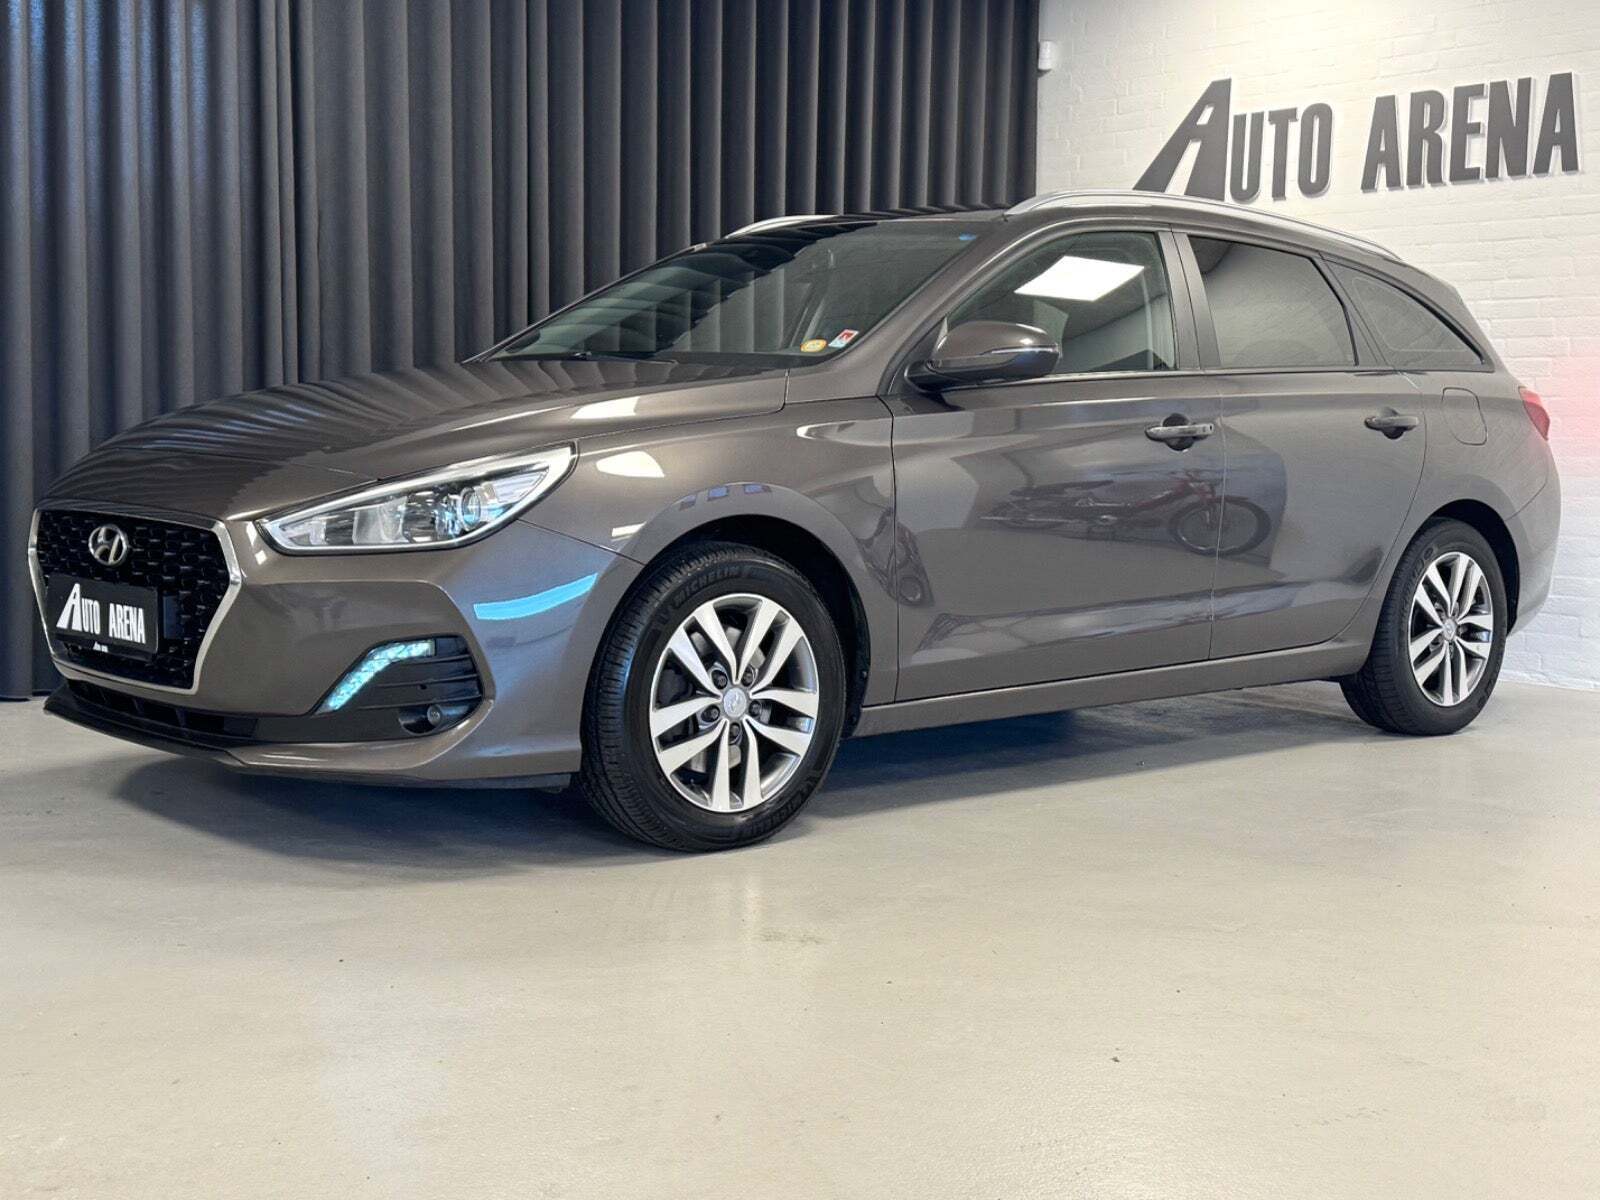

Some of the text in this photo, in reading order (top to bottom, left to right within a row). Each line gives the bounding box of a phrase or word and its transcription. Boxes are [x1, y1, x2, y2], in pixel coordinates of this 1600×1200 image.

[1133, 72, 1579, 201] AUTO ARENA
[56, 583, 146, 645] AUTO ARENA
